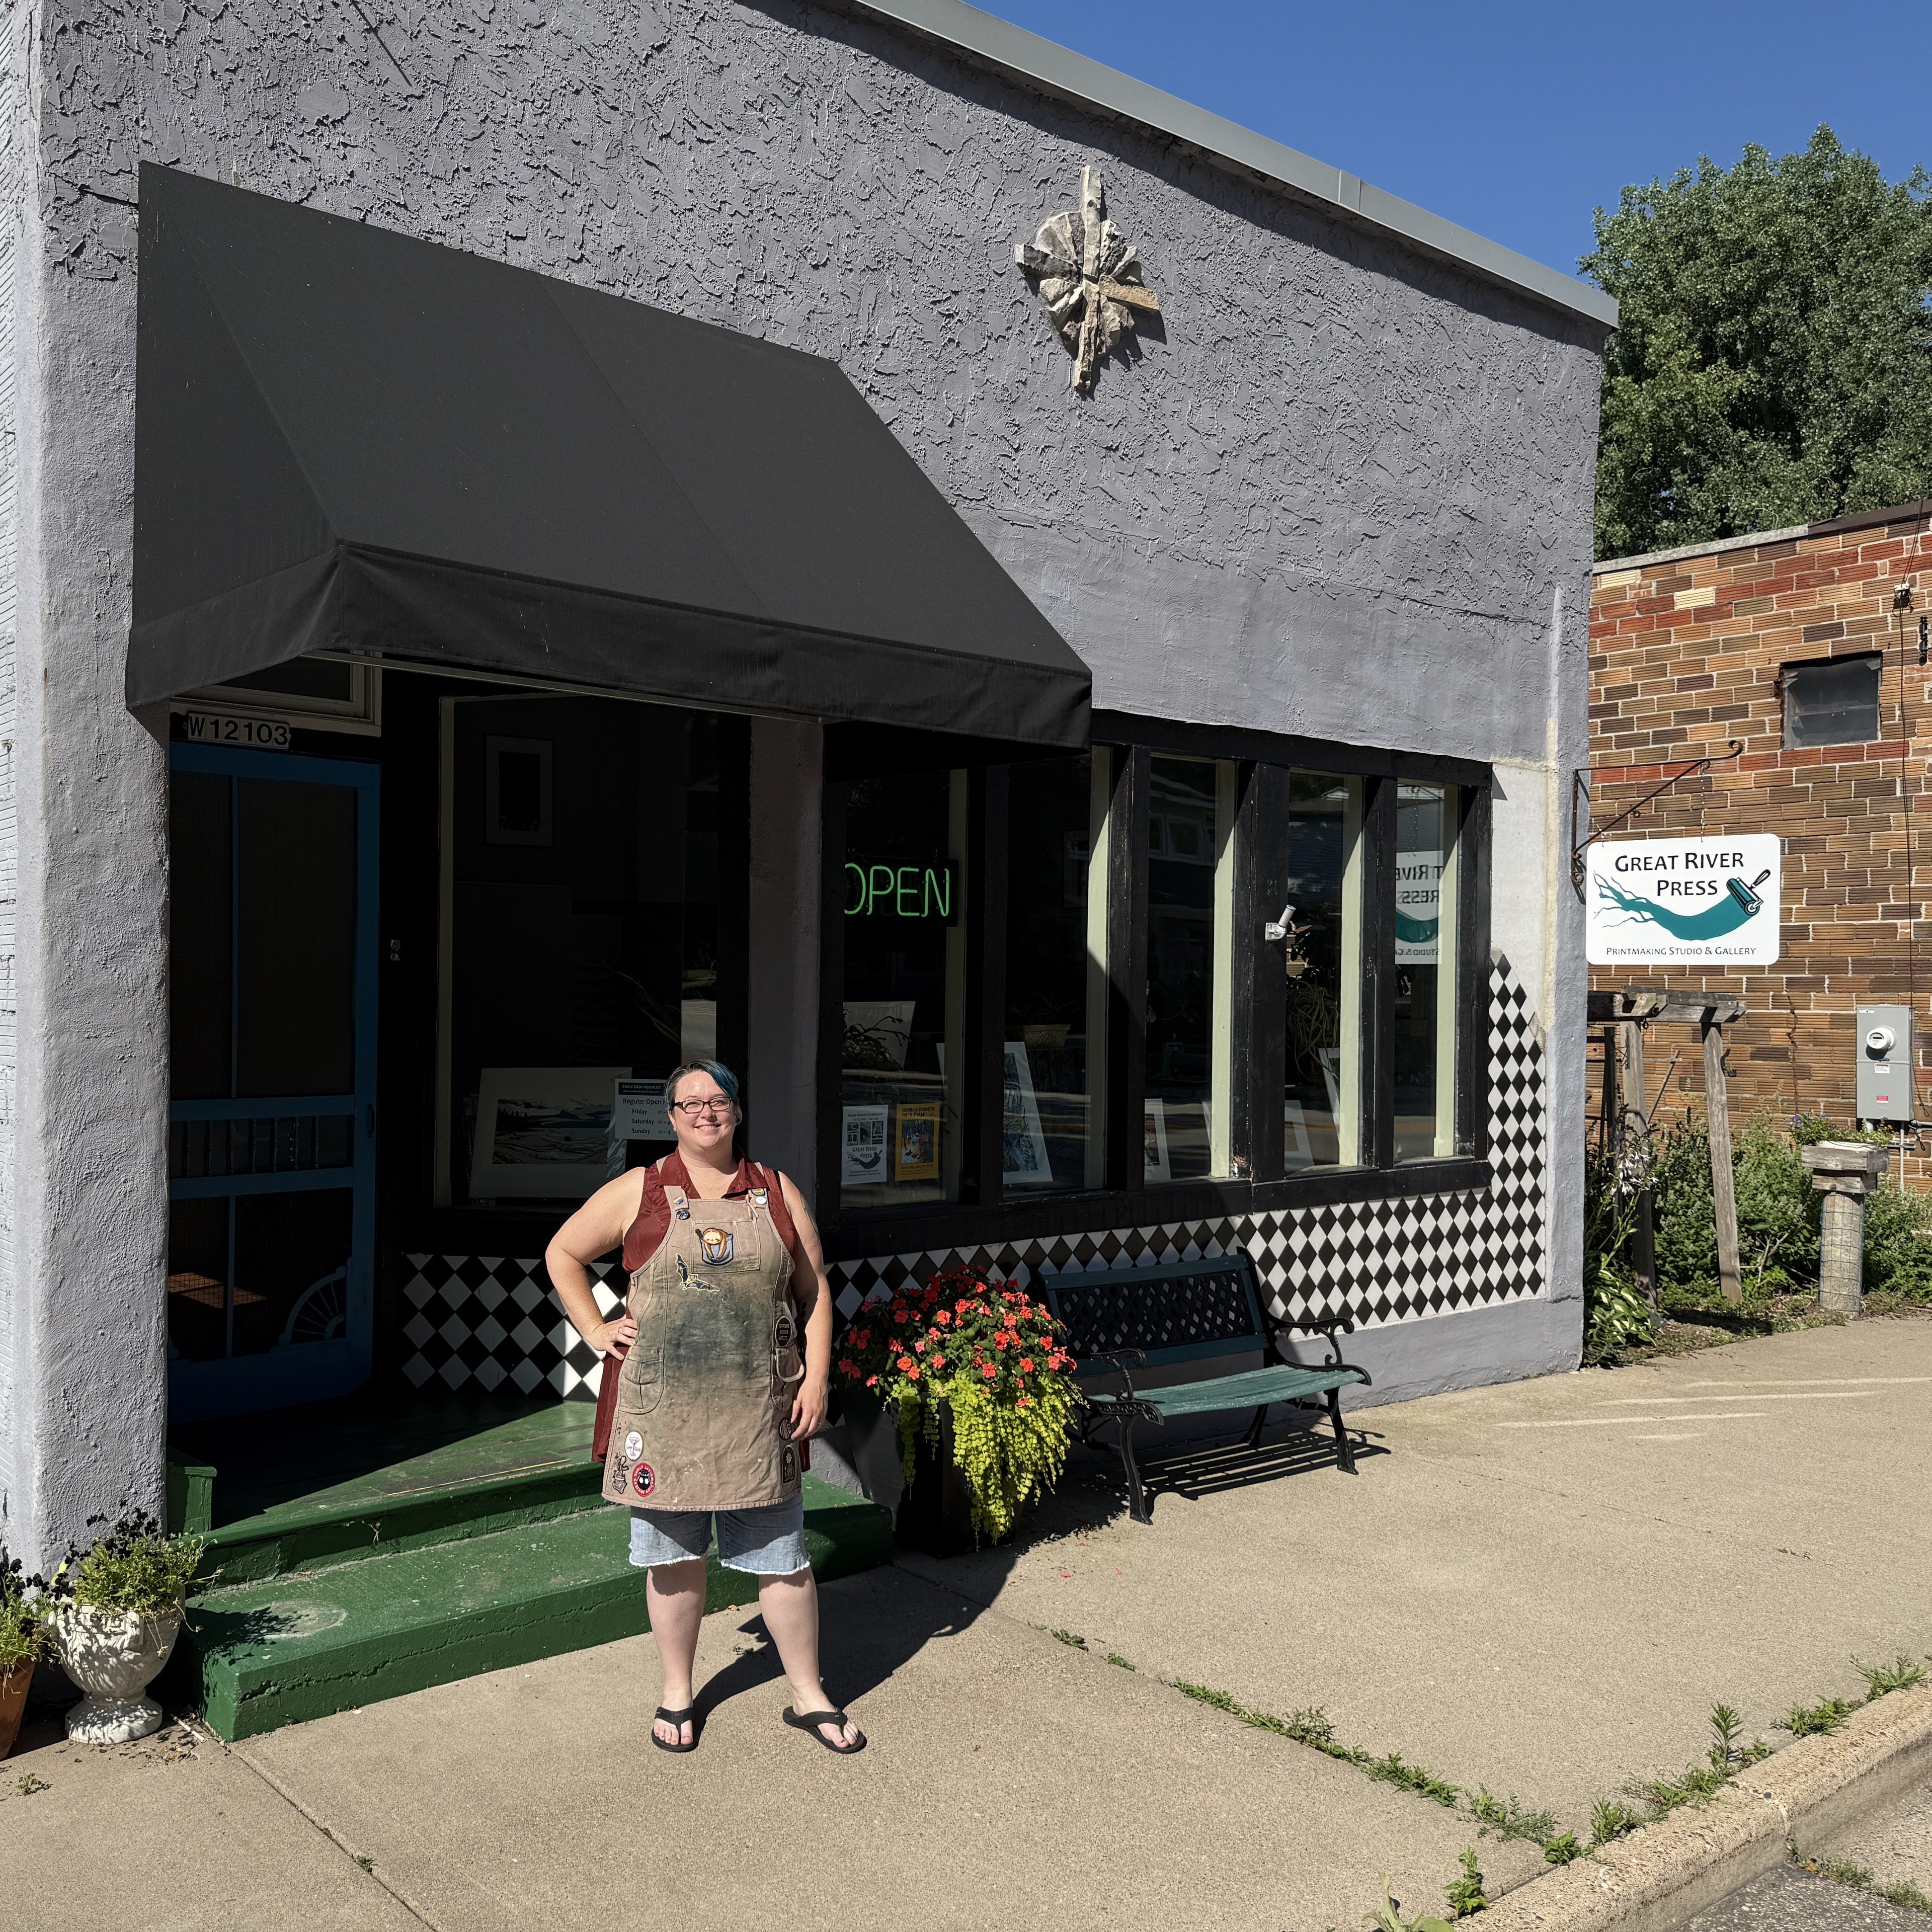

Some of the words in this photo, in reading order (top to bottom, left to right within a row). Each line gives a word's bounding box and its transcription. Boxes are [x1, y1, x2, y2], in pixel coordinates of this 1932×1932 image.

[1615, 855, 1678, 872] GREAT
[1685, 852, 1744, 869] RIVER
[844, 863, 949, 917] OPEN
[1657, 880, 1718, 896] PRESS
[1669, 947, 1702, 955] STUDIO
